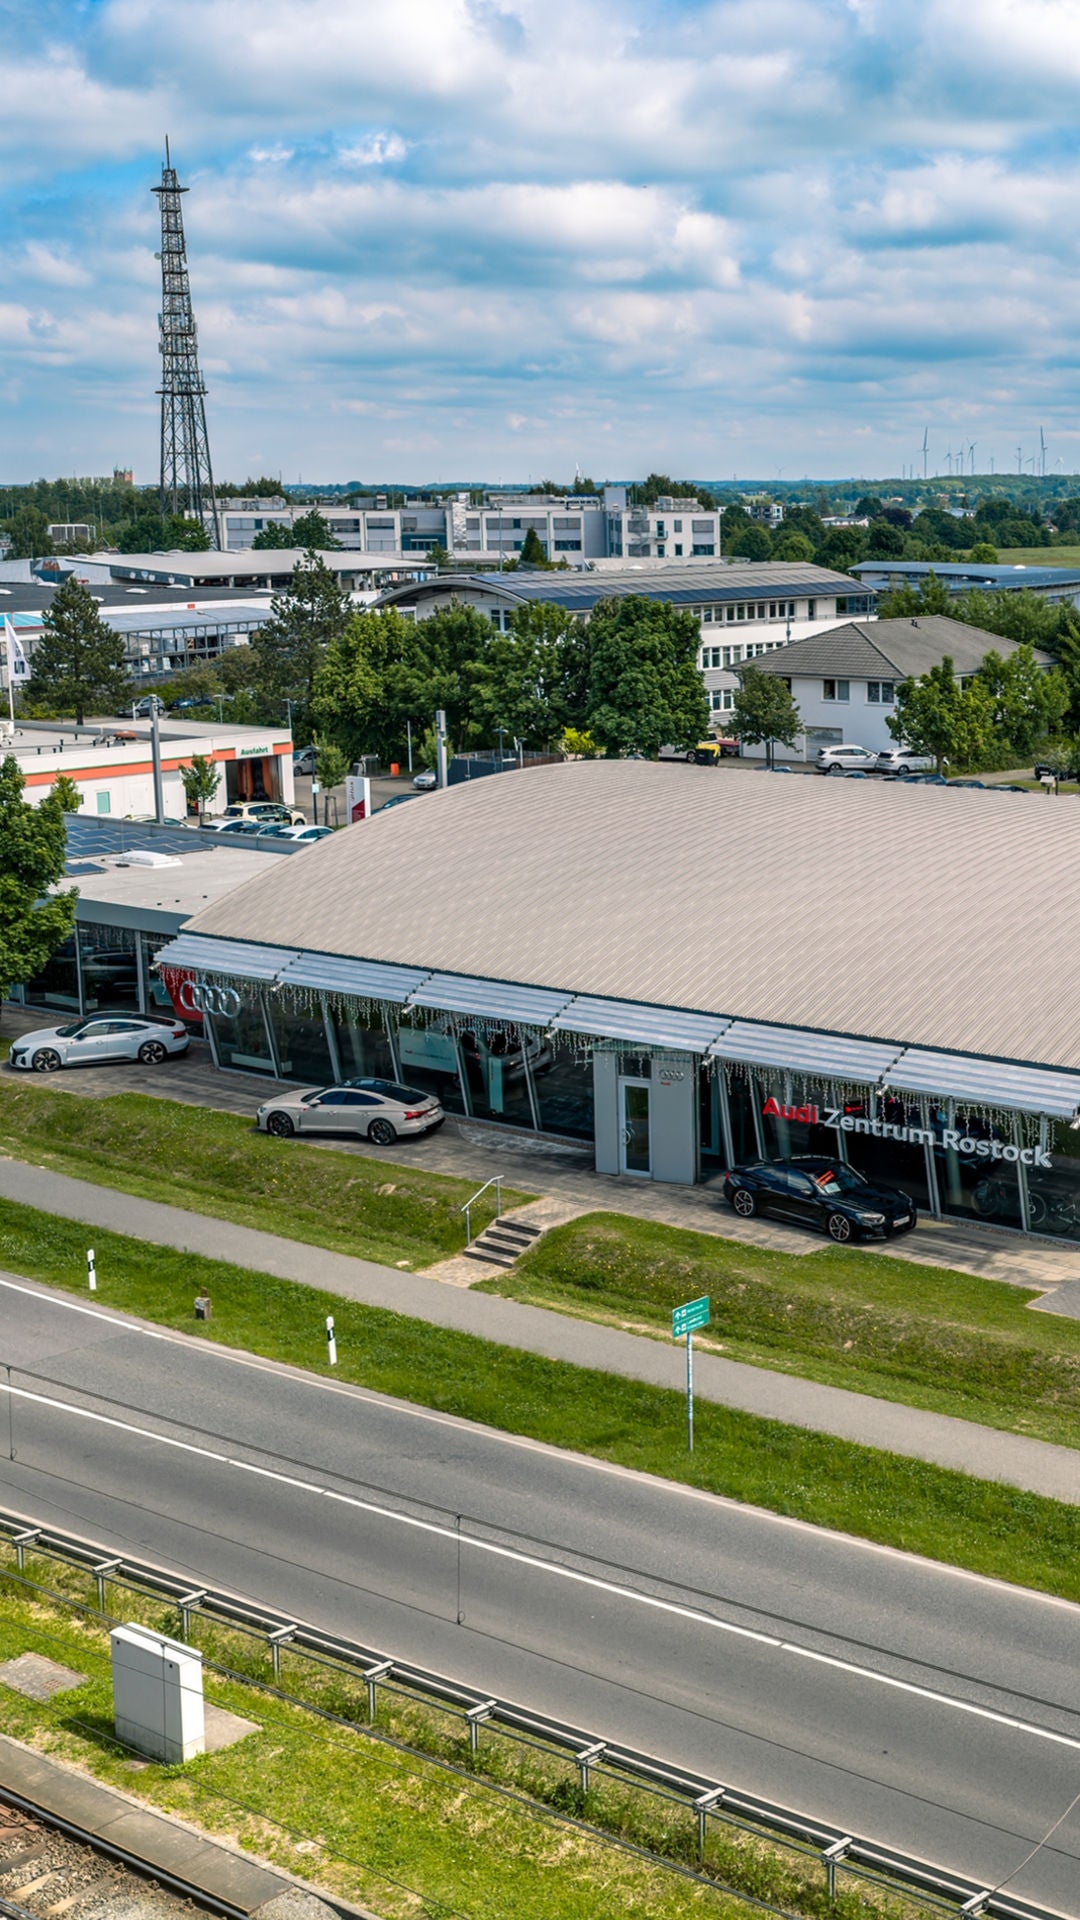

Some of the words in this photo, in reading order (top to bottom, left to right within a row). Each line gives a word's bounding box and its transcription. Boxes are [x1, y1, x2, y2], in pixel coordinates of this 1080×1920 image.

[240, 745, 269, 756] Ausfahrt
[762, 1096, 818, 1124] Audi
[822, 1107, 934, 1146] Zentrum
[942, 1128, 1052, 1168] Rostock
